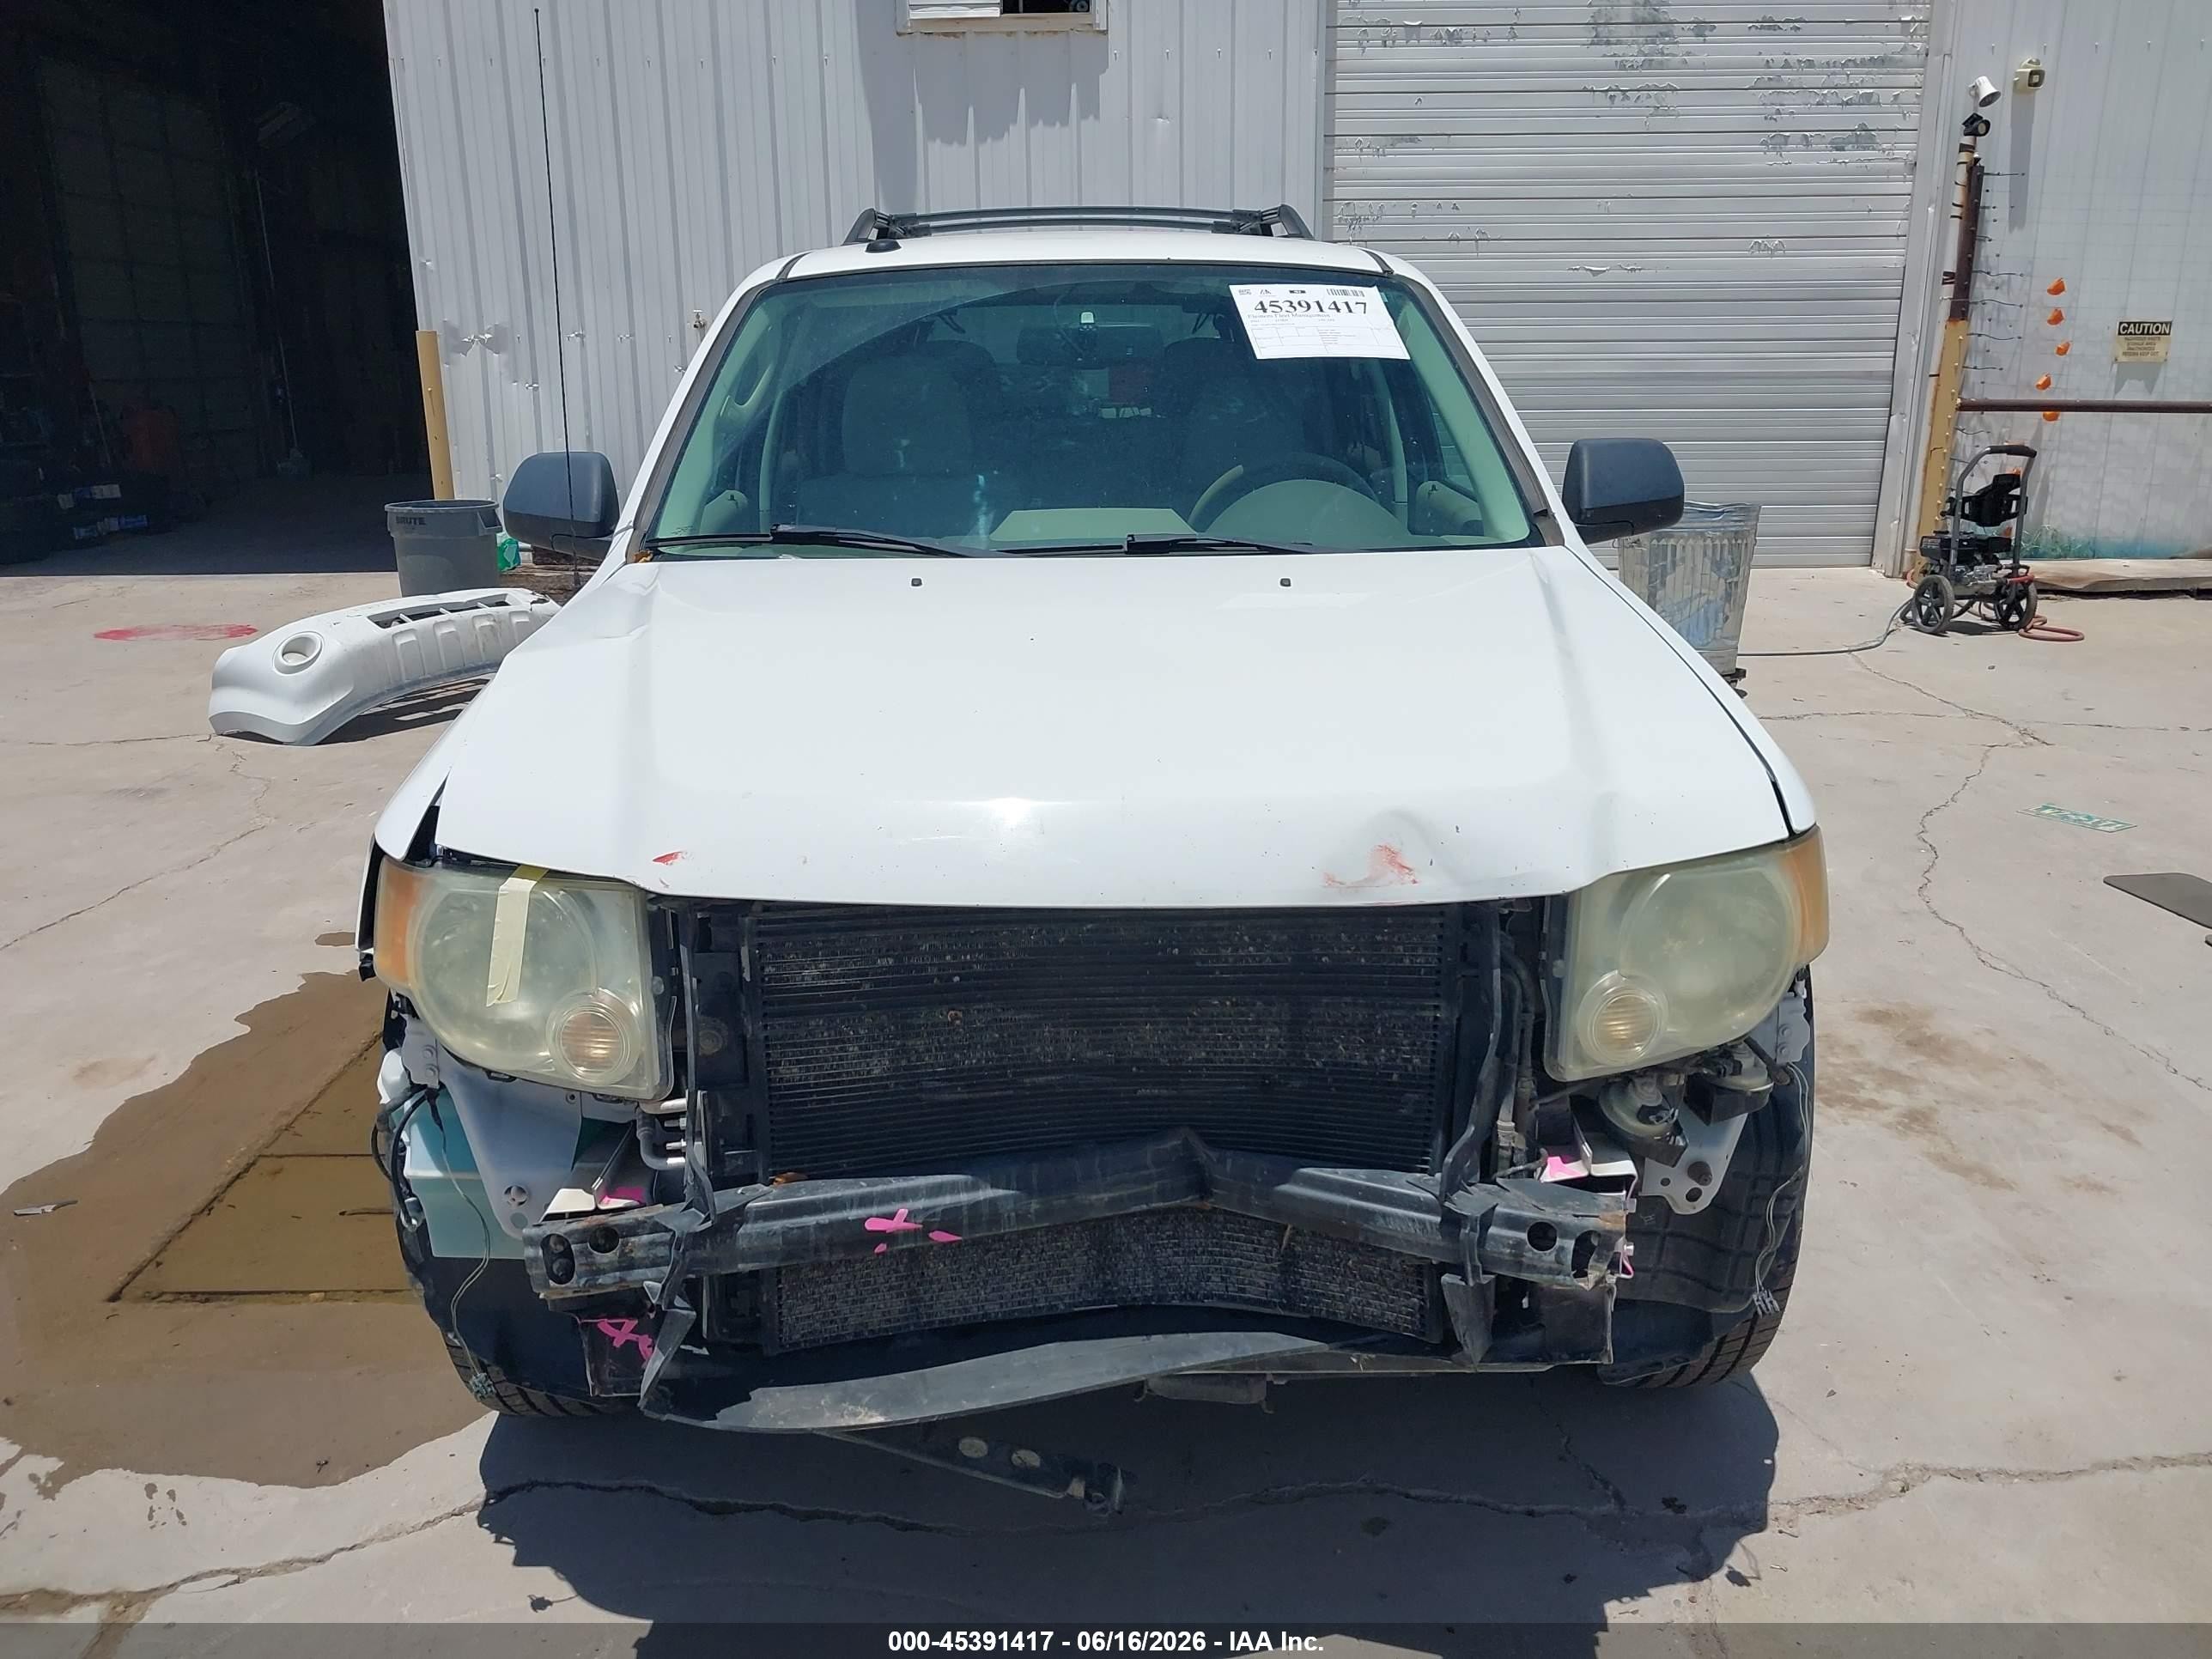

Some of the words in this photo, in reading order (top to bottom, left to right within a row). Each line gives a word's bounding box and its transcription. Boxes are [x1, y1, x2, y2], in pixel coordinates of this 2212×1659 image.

[1254, 300, 1367, 314] 45391417
[2119, 323, 2170, 335] CAUTION
[396, 516, 427, 526] BRUTE
